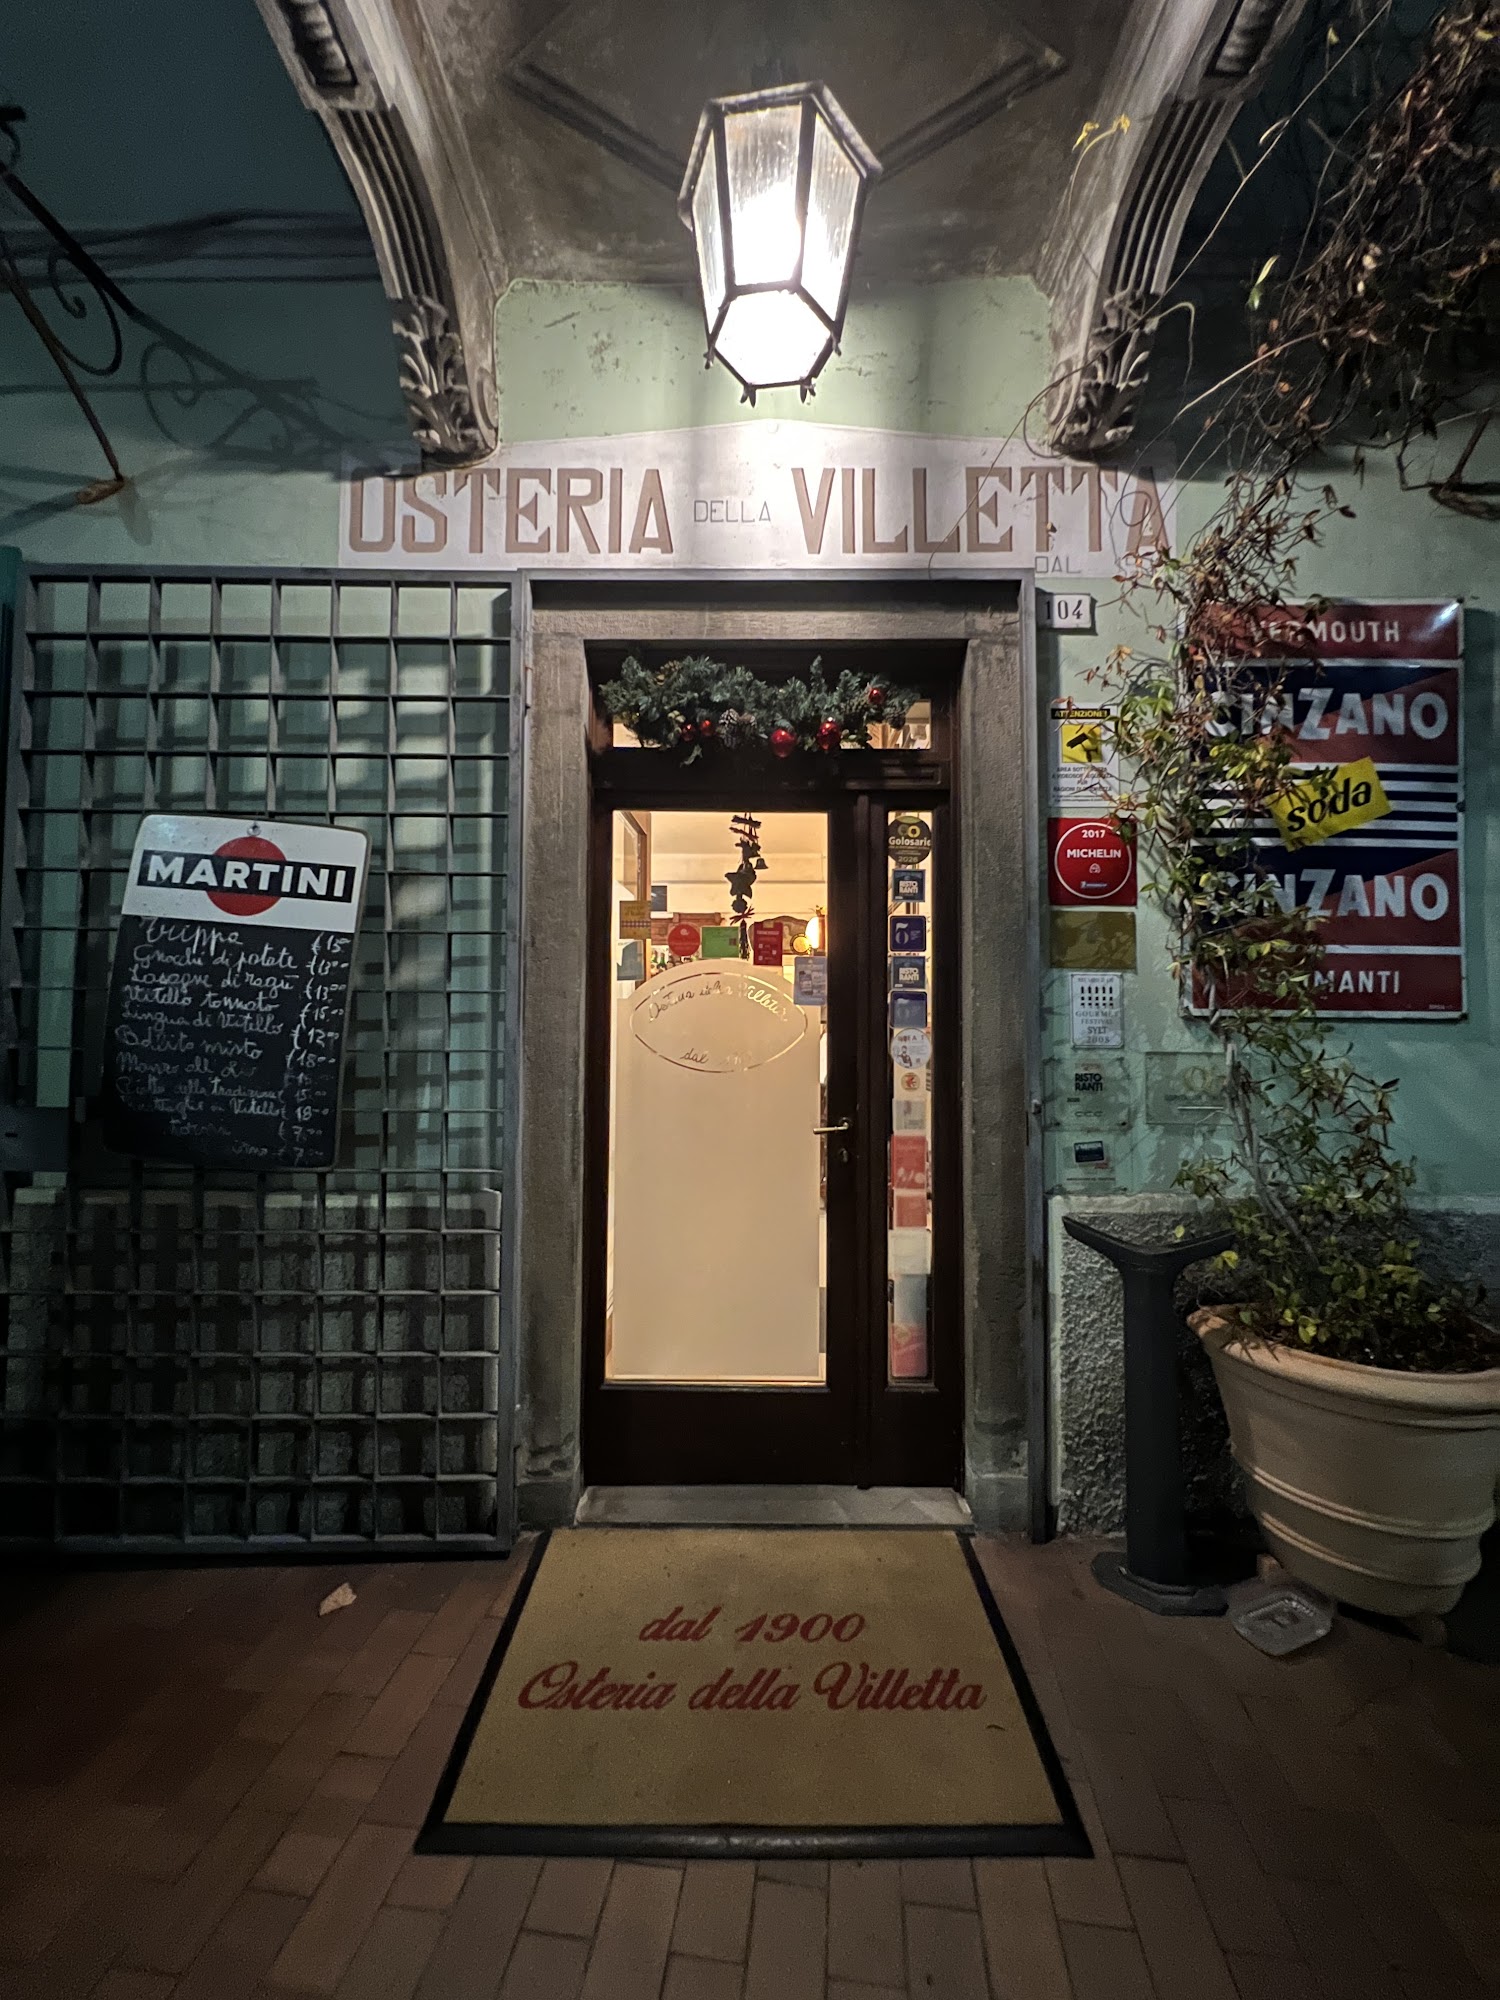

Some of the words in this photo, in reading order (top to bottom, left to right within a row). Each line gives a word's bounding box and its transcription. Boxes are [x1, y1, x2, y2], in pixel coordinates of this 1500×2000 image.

[349, 466, 674, 554] OSTERIA
[693, 499, 771, 523] DELLA
[791, 464, 1170, 554] VILLETTA
[1035, 555, 1082, 574] DAL
[1046, 599, 1083, 620] 104
[1287, 777, 1361, 832] soda
[1081, 829, 1106, 839] 2017
[1066, 848, 1122, 859] MICHELIN
[147, 855, 346, 897] MARTINI
[1075, 1073, 1102, 1082] RISTO
[1075, 1082, 1103, 1091] RANTI
[639, 1605, 722, 1643] dal
[735, 1611, 867, 1643] 1900
[518, 1660, 676, 1712] Osteria
[688, 1665, 801, 1712] della
[812, 1660, 988, 1712] Villetta
